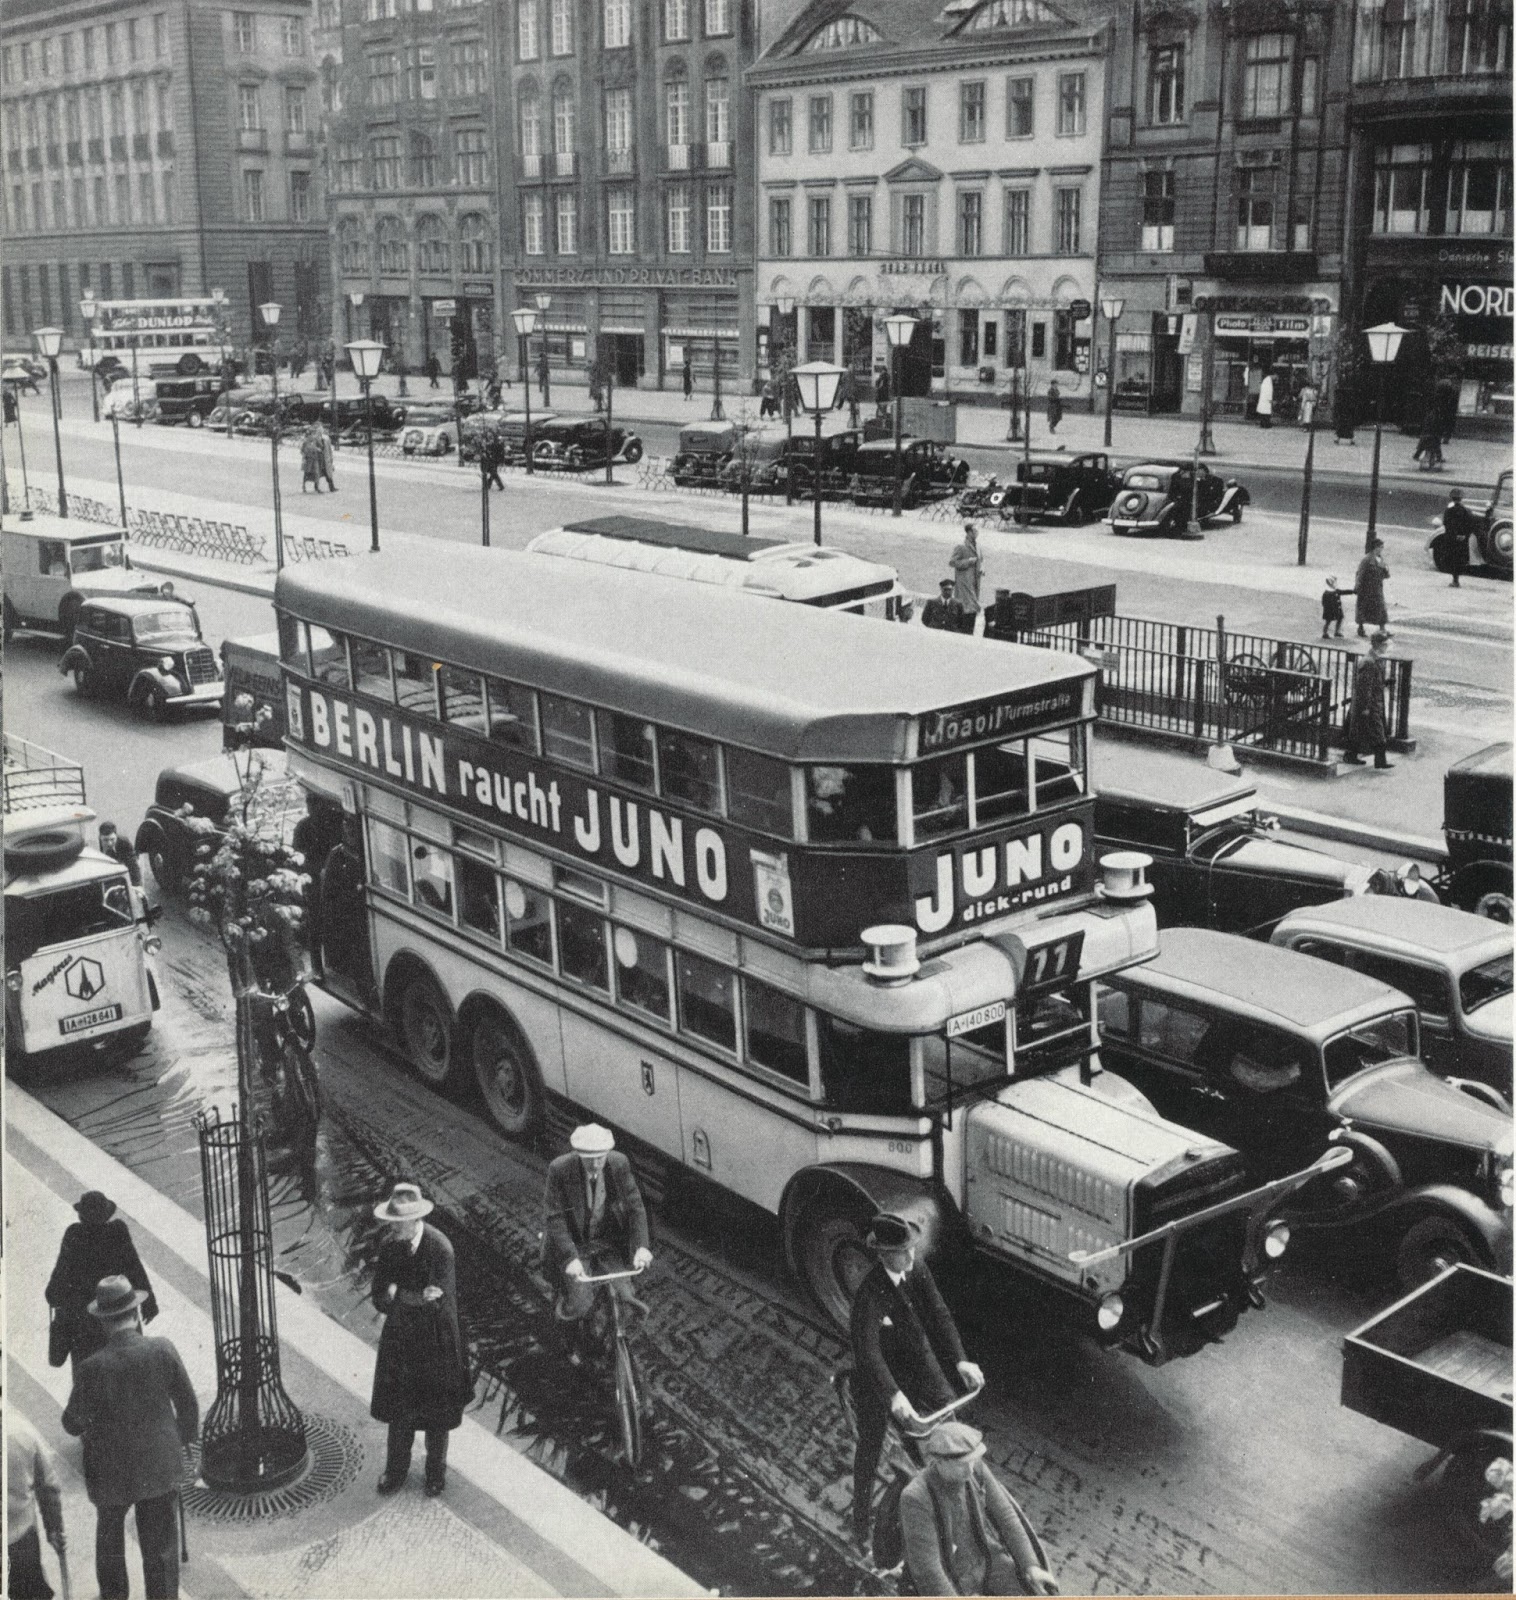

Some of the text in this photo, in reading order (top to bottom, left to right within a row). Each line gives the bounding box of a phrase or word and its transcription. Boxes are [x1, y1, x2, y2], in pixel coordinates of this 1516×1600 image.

[138, 315, 193, 328] DUNLOP
[1279, 320, 1305, 331] Film
[308, 690, 728, 902] BERLIN raucht JUNO
[914, 822, 1083, 933] JUNO
[962, 876, 1072, 922] dick-rund
[888, 1140, 912, 1154] 800
